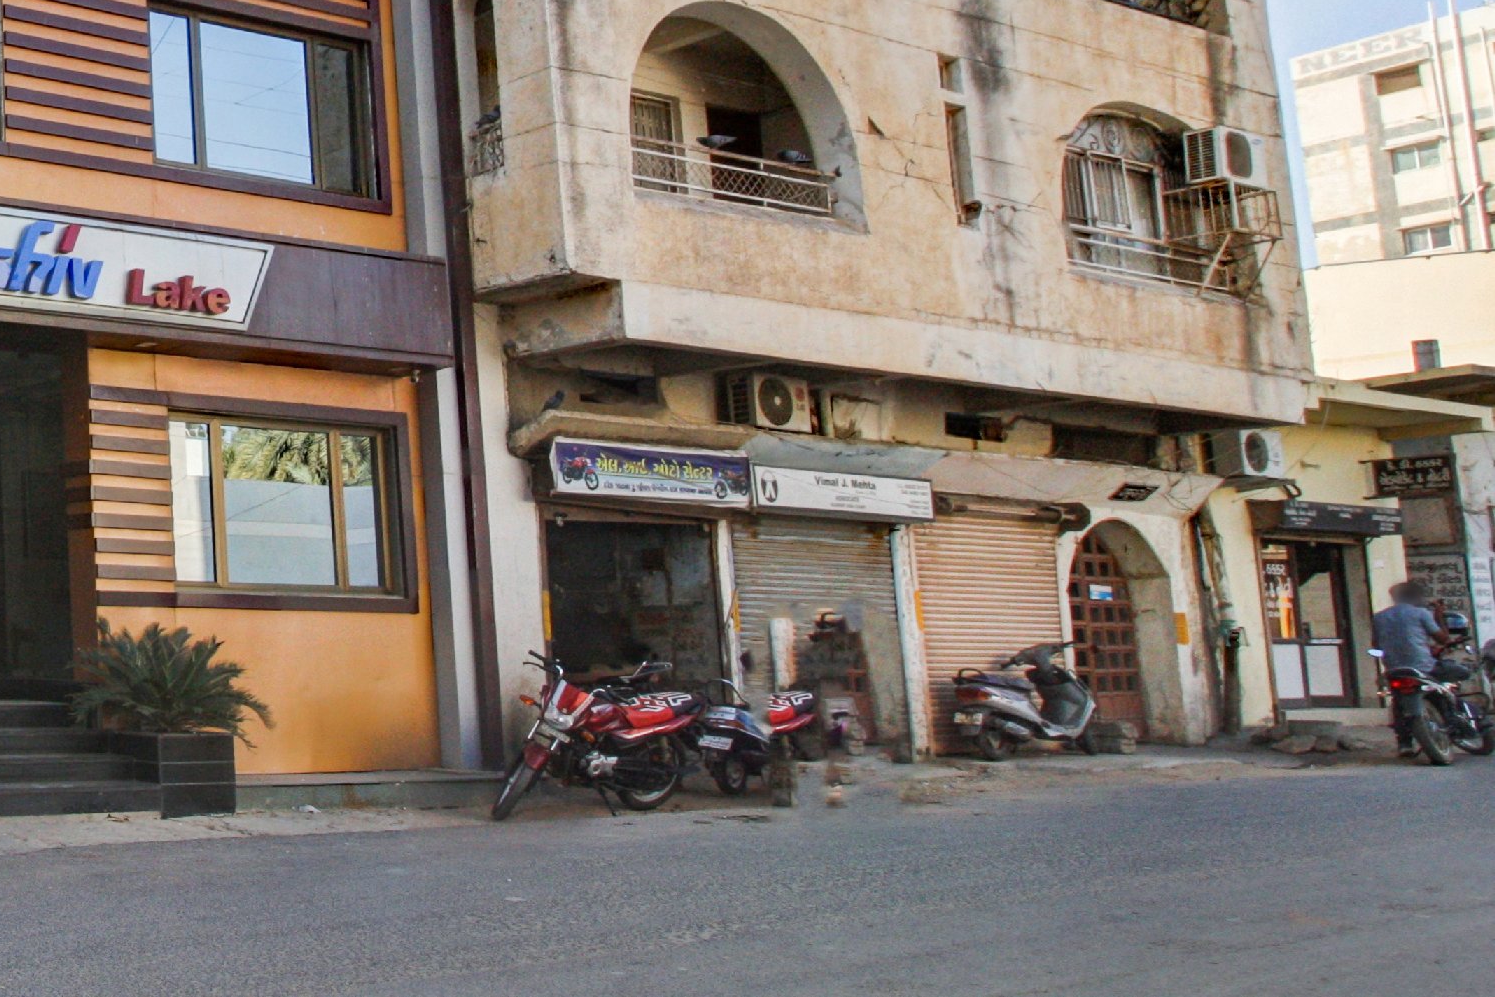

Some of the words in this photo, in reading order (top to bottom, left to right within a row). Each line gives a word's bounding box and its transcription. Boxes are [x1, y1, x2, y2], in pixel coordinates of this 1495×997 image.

[125, 267, 232, 316] Lake
[814, 475, 839, 486] Vimal
[851, 479, 876, 490] Mehta
